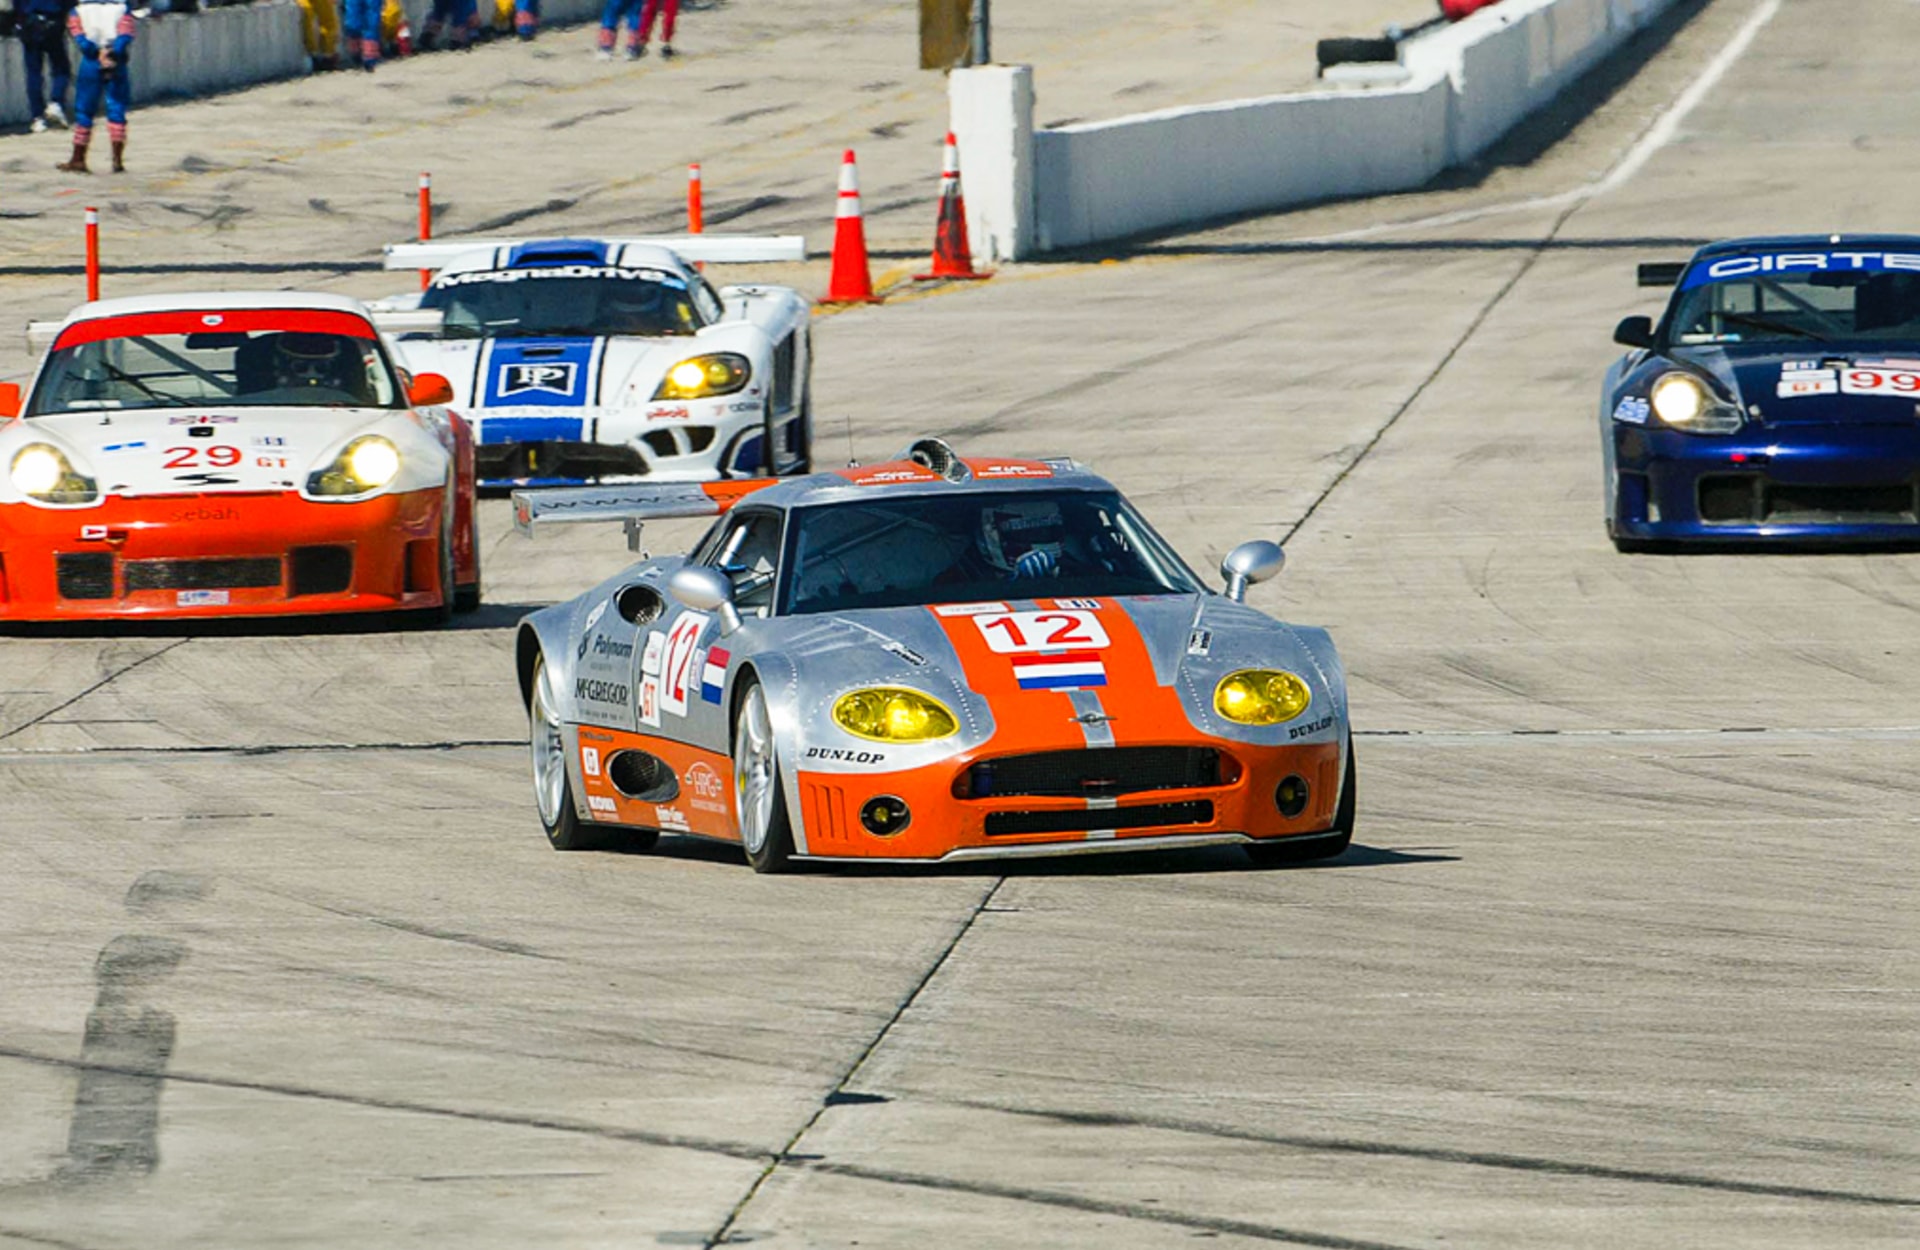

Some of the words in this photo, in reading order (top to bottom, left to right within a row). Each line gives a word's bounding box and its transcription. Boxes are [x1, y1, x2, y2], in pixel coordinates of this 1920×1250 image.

[436, 265, 665, 289] MagnaDrive
[1850, 371, 1920, 392] 99
[162, 445, 243, 469] 29
[256, 456, 290, 469] GT
[169, 509, 240, 522] sebah
[985, 615, 1093, 646] 12
[667, 618, 699, 704] 12
[1288, 716, 1333, 740] DUNLOP
[806, 747, 885, 765] DUNLOP
